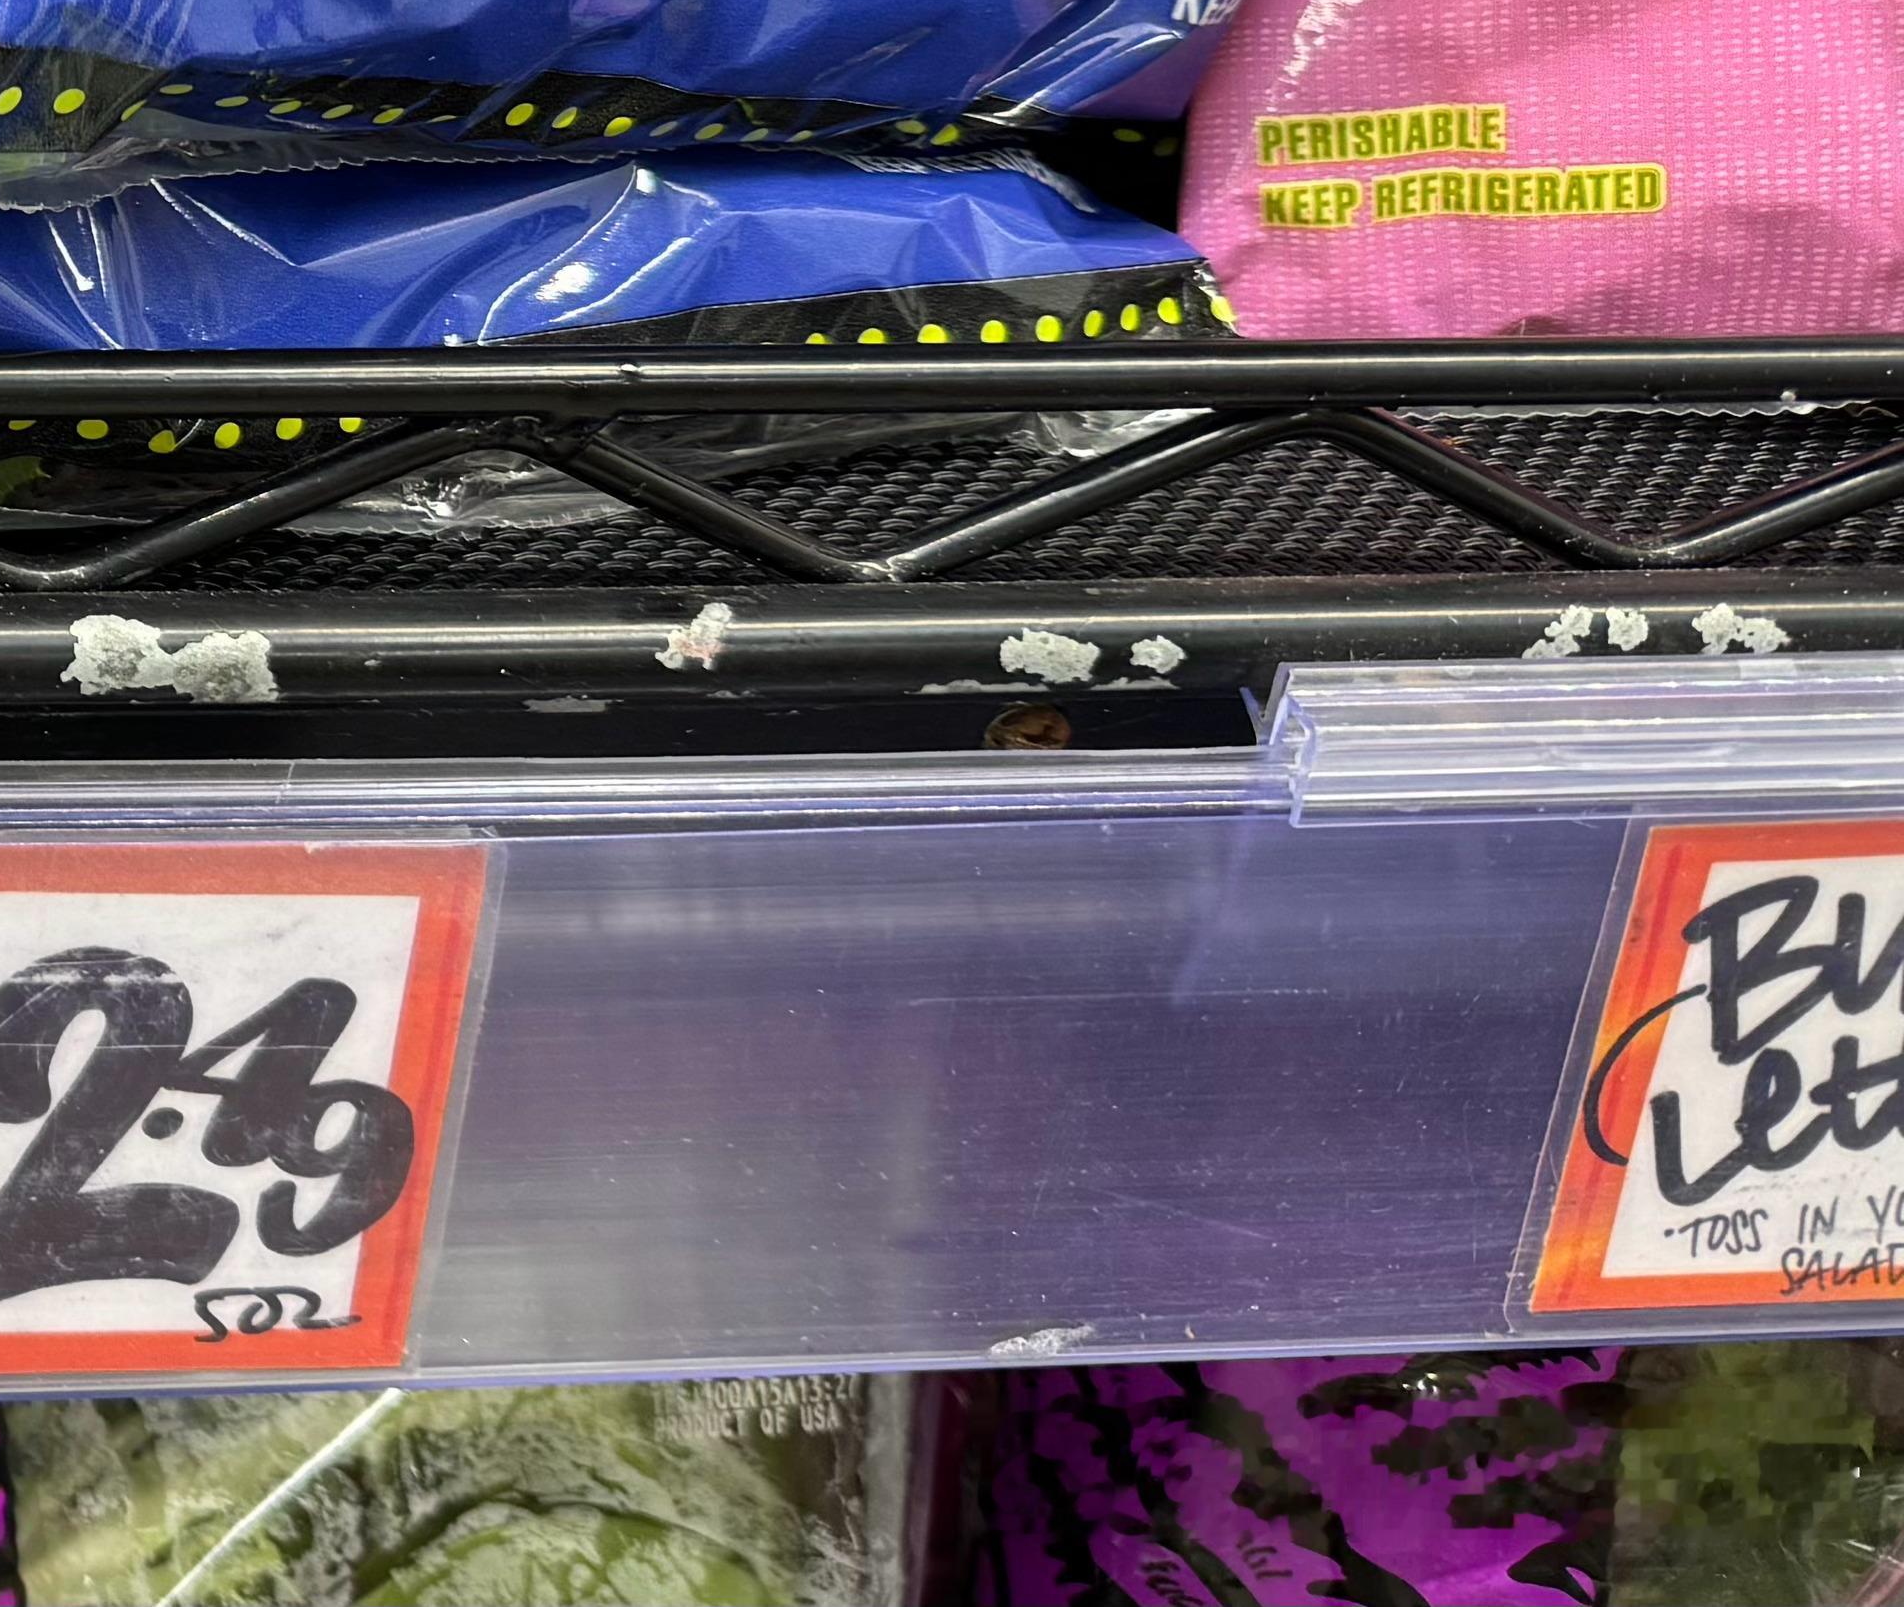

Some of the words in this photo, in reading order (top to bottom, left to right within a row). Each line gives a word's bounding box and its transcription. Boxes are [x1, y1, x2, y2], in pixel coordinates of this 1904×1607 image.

[1259, 107, 1503, 163] PERISHABLE
[1261, 182, 1359, 226] KEEP
[1374, 166, 1662, 219] REFRIGERATED
[1650, 1035, 1904, 1206] Let
[1797, 1197, 1839, 1245] IN
[654, 1409, 746, 1442] PRODUCT
[760, 1405, 788, 1437] OF
[800, 1402, 842, 1435] USA
